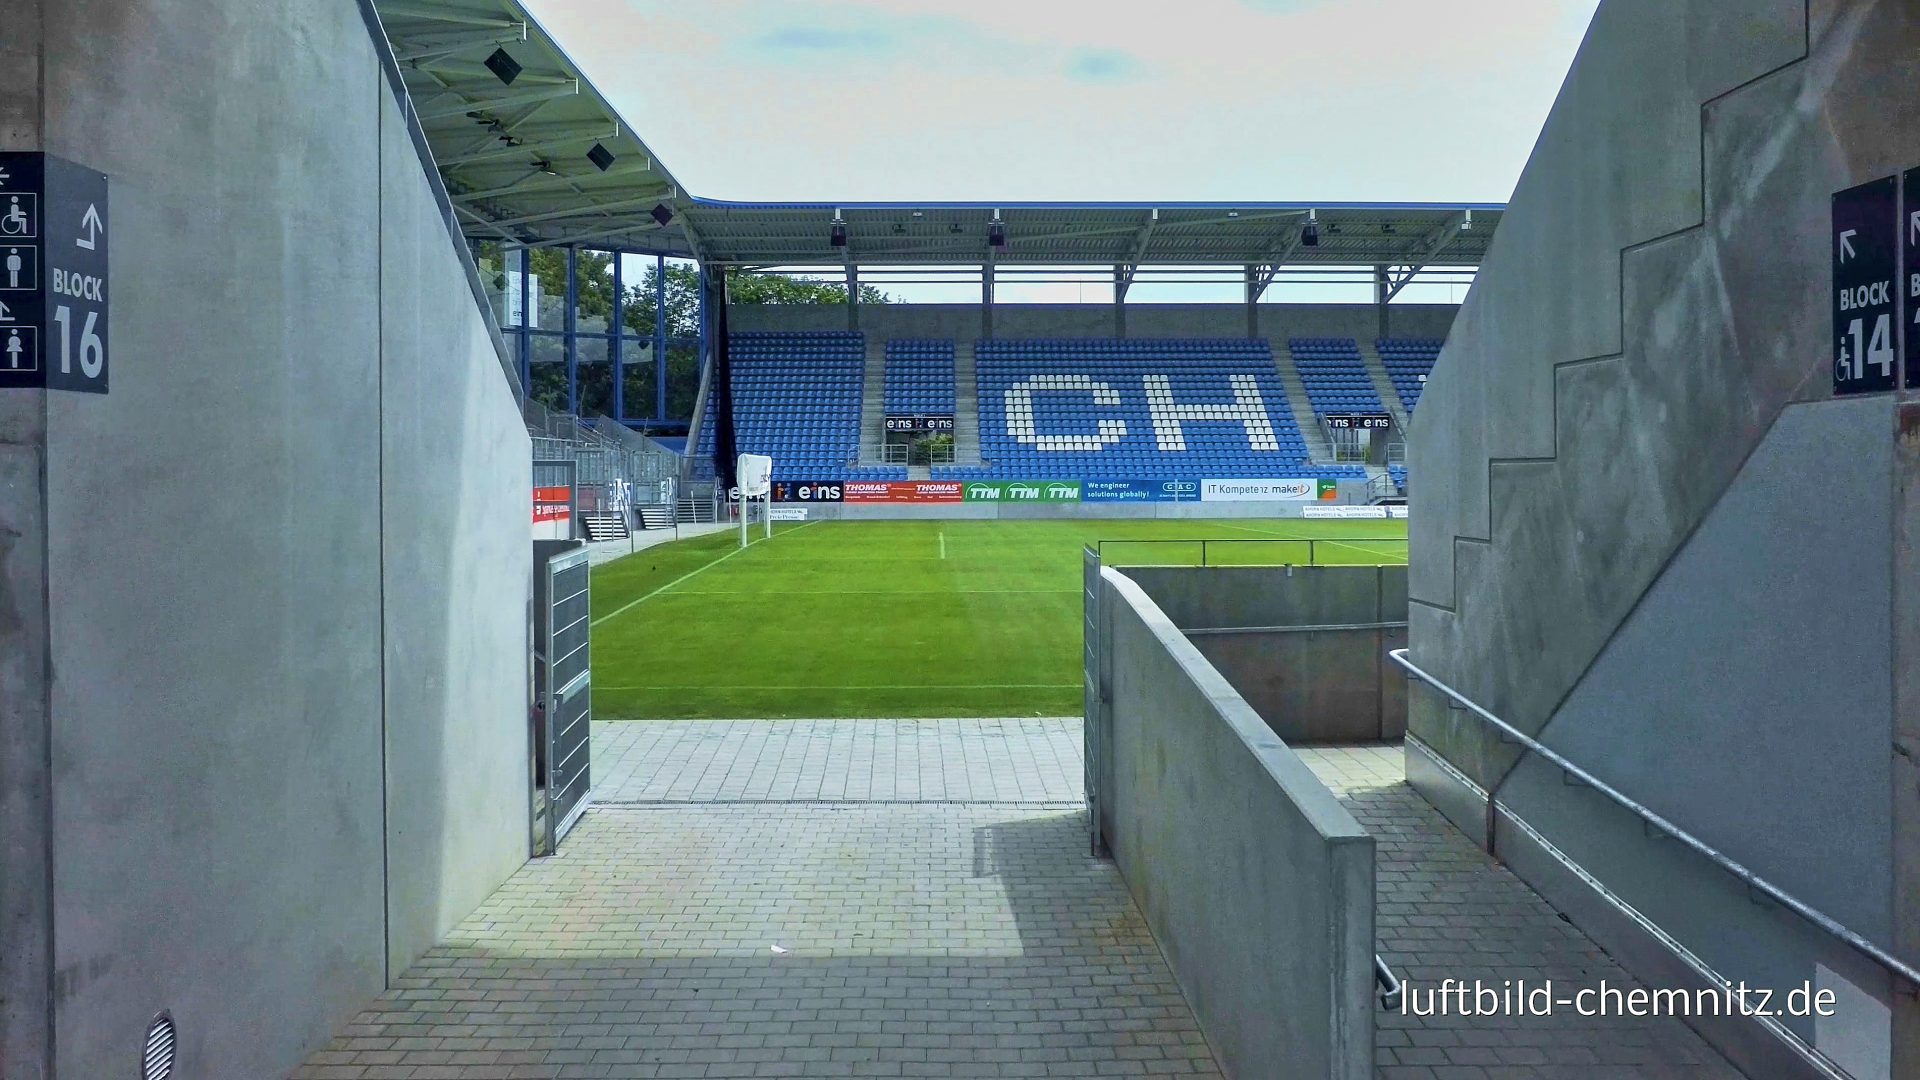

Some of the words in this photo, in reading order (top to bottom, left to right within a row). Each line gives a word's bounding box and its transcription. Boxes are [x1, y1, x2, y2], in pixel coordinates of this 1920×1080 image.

[53, 268, 102, 302] BLOCK
[1840, 281, 1890, 310] BLOCK
[54, 305, 103, 378] 16
[1847, 313, 1894, 379] 14
[798, 482, 841, 499] eins
[970, 488, 1000, 498] TTM
[1009, 488, 1040, 498] TTM
[1048, 488, 1079, 498] TTM
[1087, 490, 1118, 498] solutions
[1119, 490, 1150, 499] globally!
[1100, 482, 1130, 490] engineer
[1208, 485, 1217, 493] IT
[1219, 485, 1268, 496] Kompetenz
